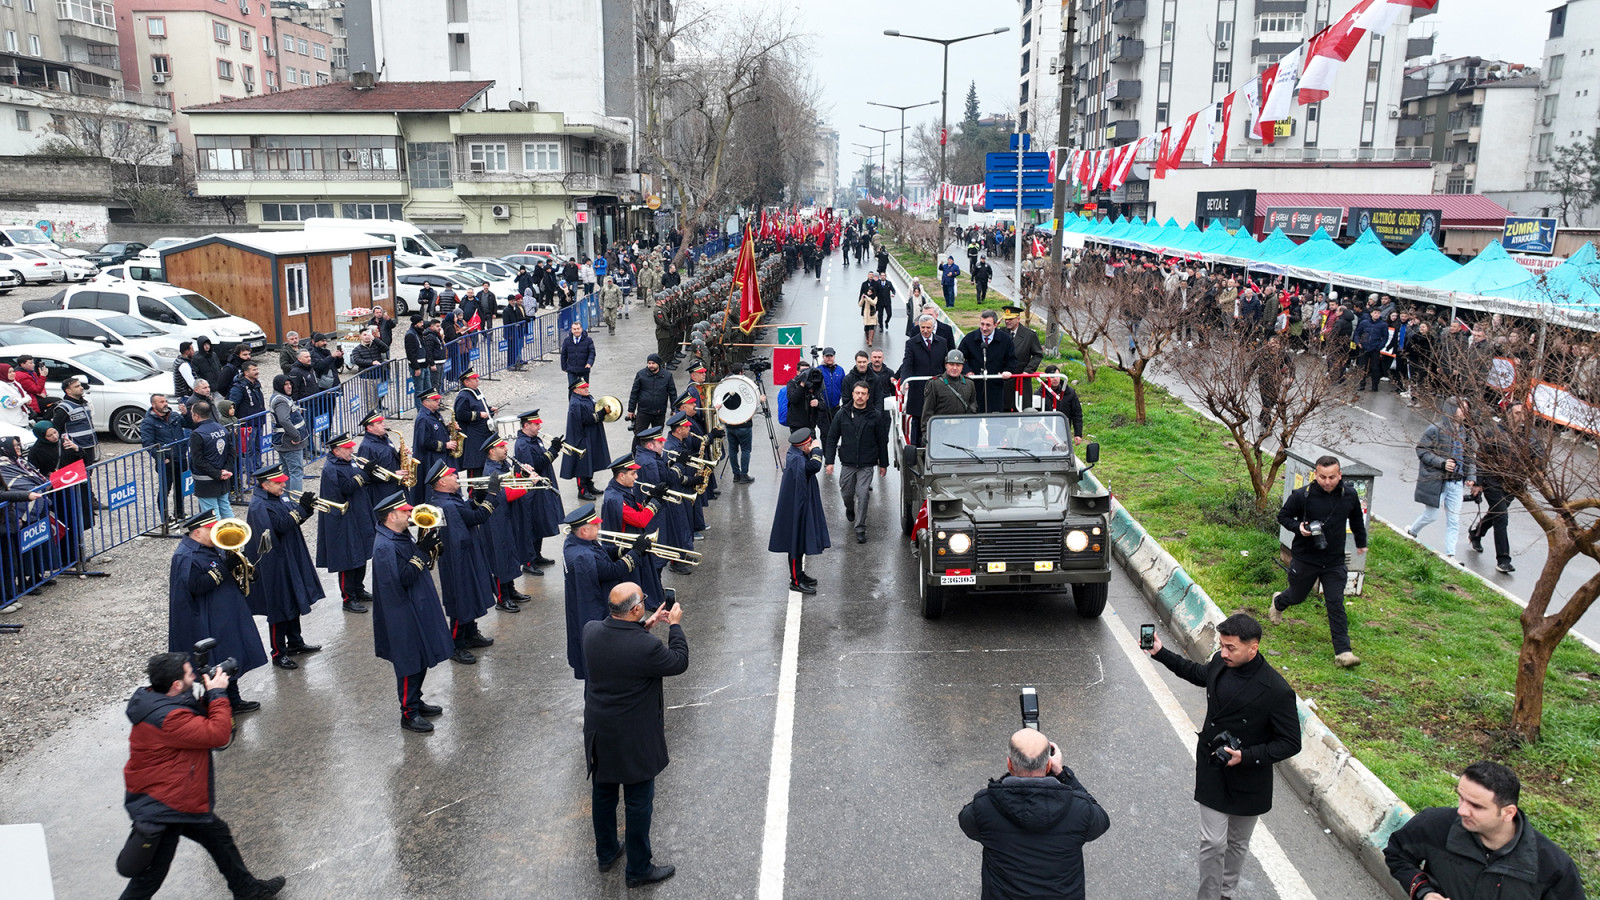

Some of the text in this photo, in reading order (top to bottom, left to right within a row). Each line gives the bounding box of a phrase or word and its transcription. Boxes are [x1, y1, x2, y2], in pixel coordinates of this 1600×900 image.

[1207, 198, 1230, 211] BEYZA E
[1372, 210, 1421, 230] ALTINÖZ GÜMÜŞ
[1399, 228, 1414, 236] SAAT
[1505, 220, 1540, 236] ZÜMRA
[1511, 233, 1540, 245] AYAKKABI
[941, 576, 975, 584] 236305
